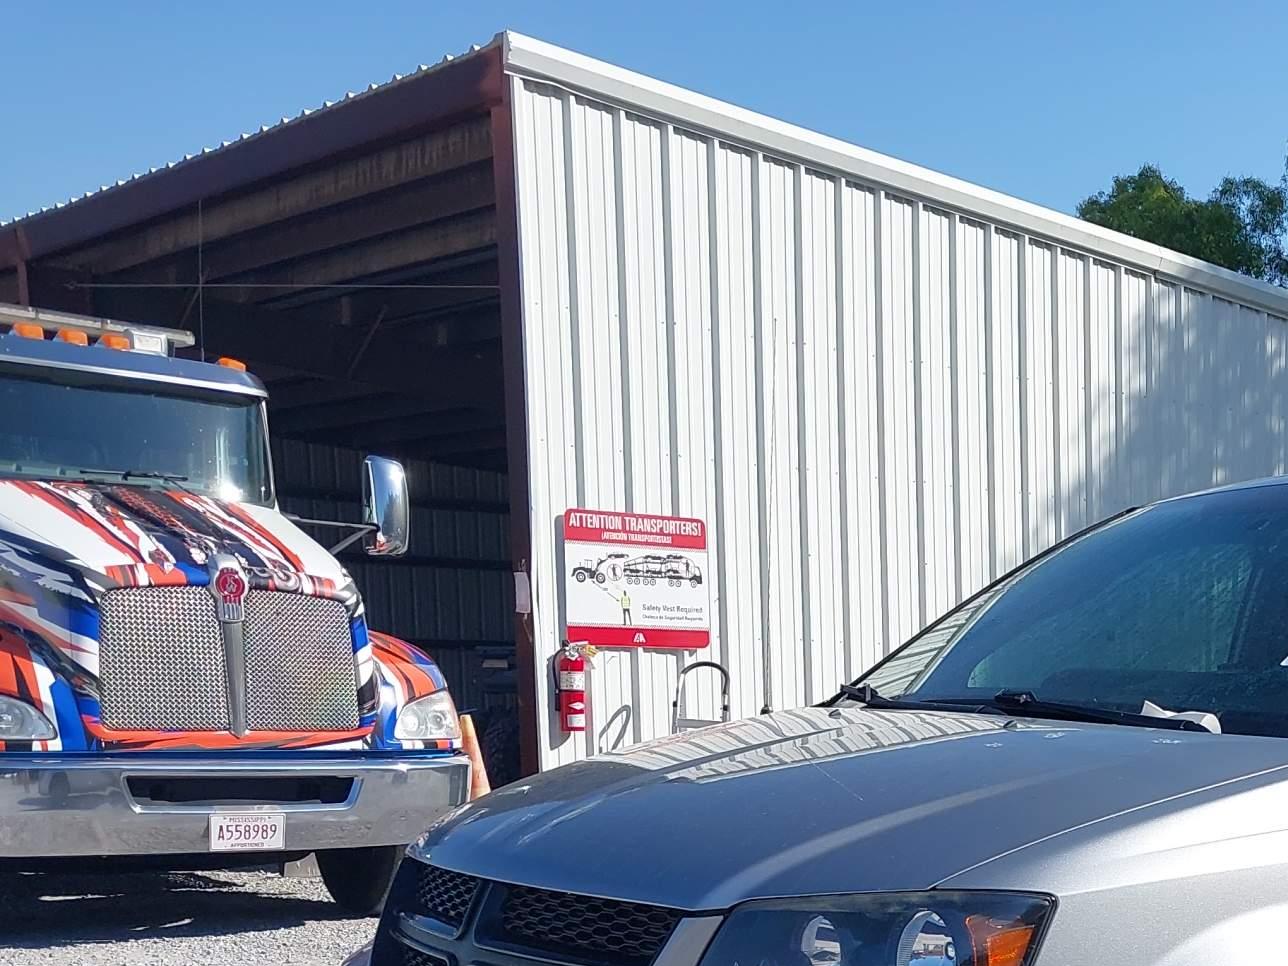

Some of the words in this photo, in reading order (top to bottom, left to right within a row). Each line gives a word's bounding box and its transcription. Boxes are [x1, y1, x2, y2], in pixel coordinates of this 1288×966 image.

[568, 512, 622, 530] ATTENTION
[624, 516, 702, 537] TRANSPORTERS!
[642, 603, 661, 614] Safety
[676, 605, 703, 615] Required
[217, 823, 278, 841] A558989
